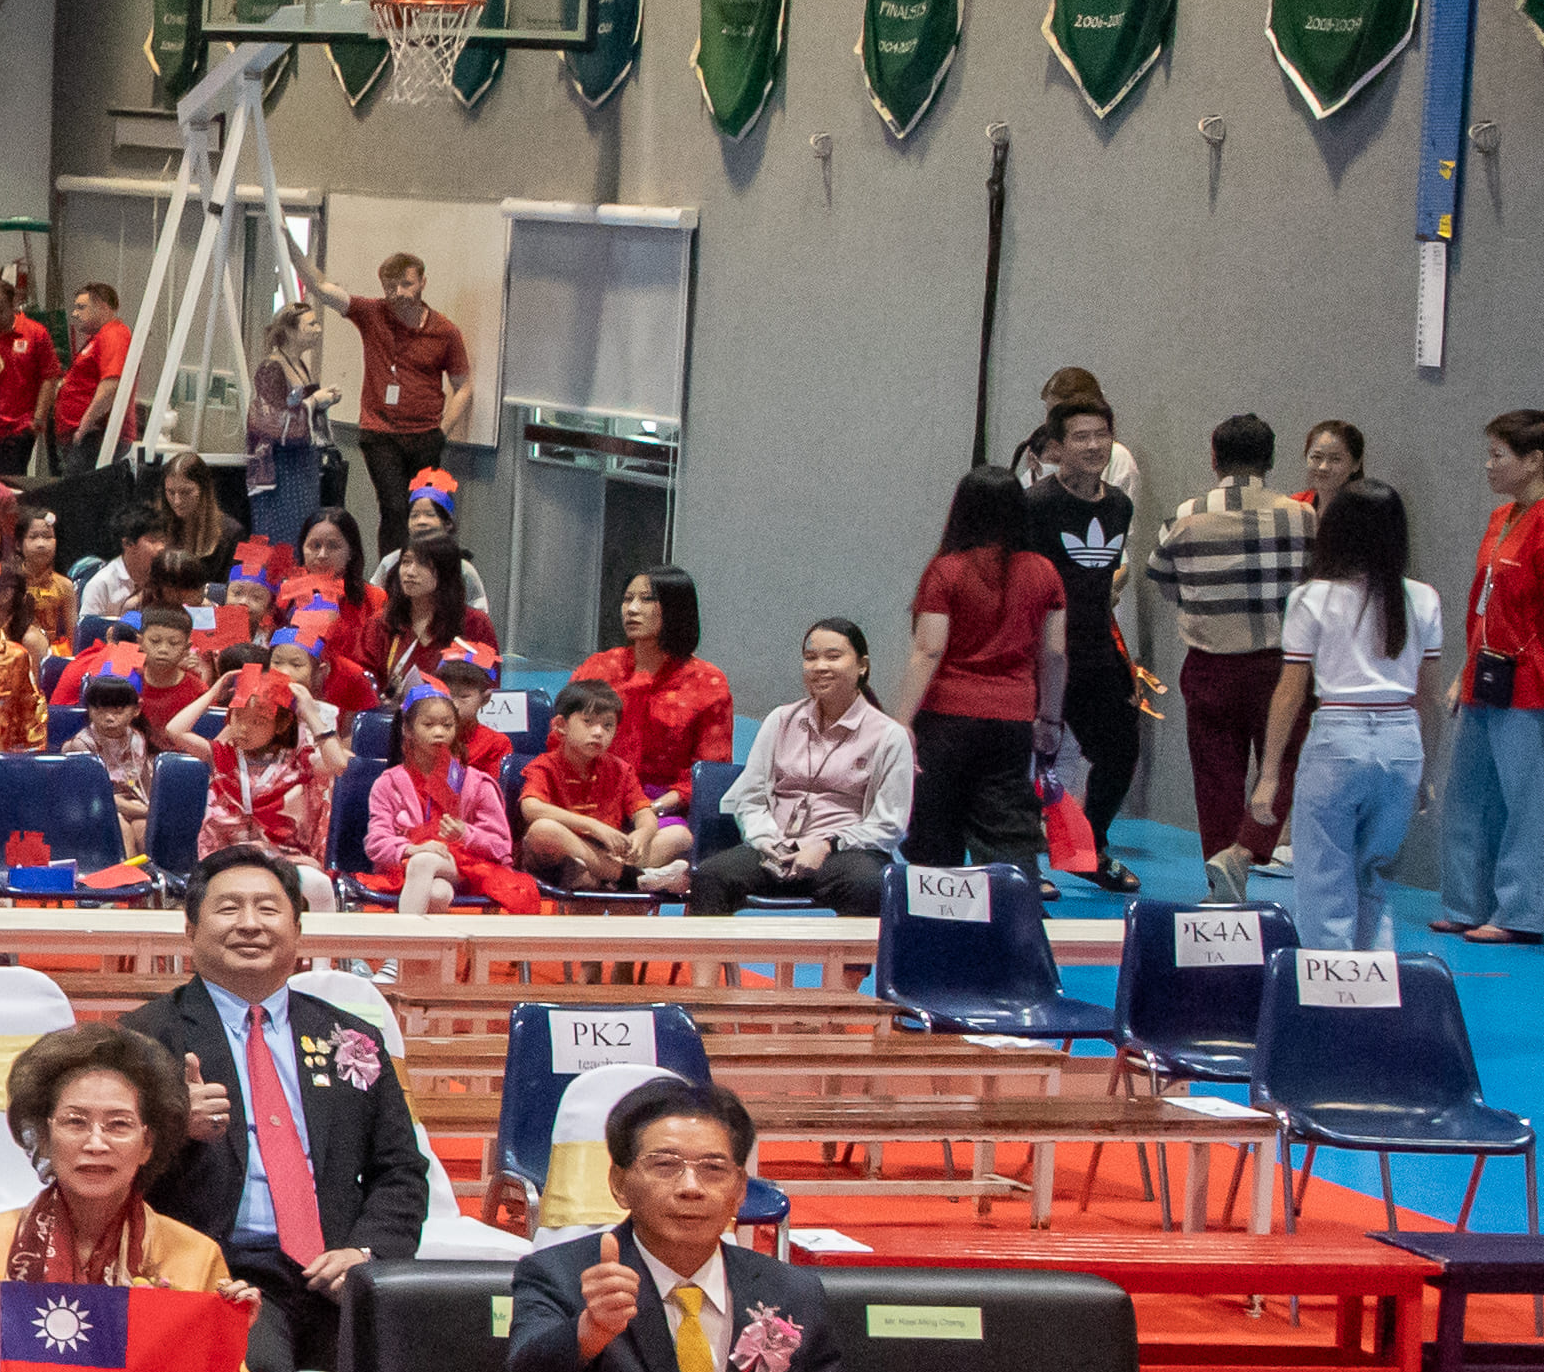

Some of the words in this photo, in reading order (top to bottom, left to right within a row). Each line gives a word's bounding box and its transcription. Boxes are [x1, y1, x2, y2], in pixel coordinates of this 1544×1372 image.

[918, 873, 976, 901] KGA
[937, 904, 956, 918] TA
[1205, 951, 1226, 964] TA
[1305, 958, 1389, 984] PK3A
[1335, 991, 1357, 1004] TA
[572, 1021, 632, 1047] PK2
